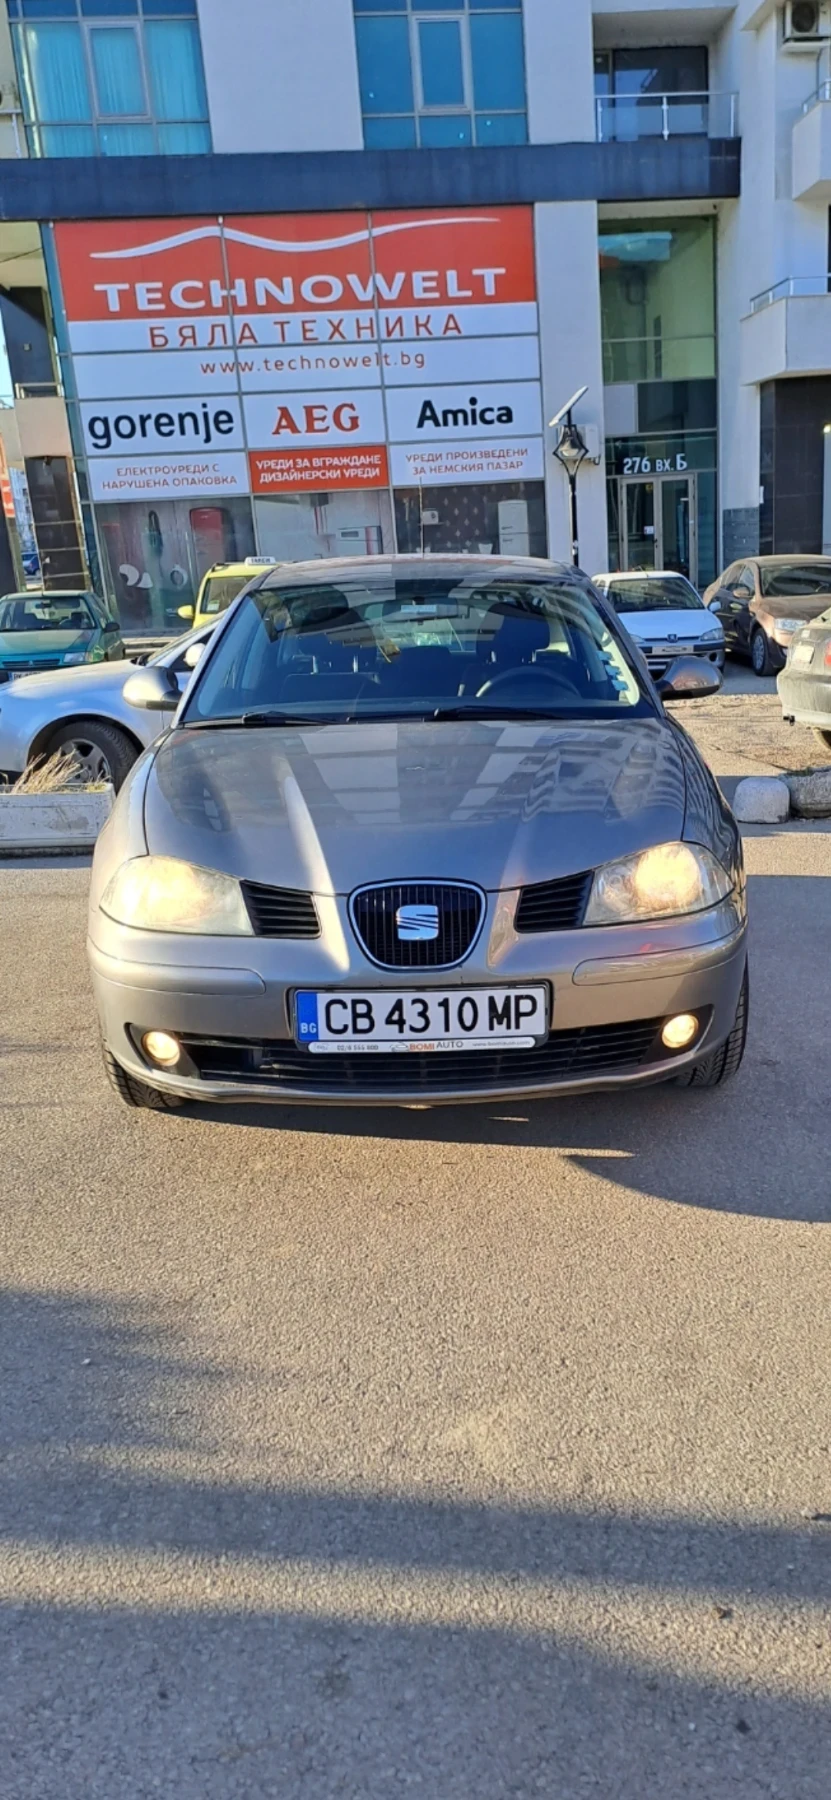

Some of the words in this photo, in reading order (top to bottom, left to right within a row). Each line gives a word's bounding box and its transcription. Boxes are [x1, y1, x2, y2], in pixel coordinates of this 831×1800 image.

[93, 267, 506, 312] TECHNOWELT
[149, 322, 258, 348] БЯЛА
[273, 313, 462, 344] ТЕХНИКА
[200, 352, 426, 374] www.technowelt.bg
[271, 403, 360, 435] AEG
[416, 397, 513, 429] Amica
[88, 402, 234, 450] gorenje
[256, 459, 293, 470] УРЕДИ
[296, 458, 310, 468] ЗА
[312, 455, 381, 468] ВГРАЖДАНЕ
[405, 453, 443, 463] УРЕДИ
[445, 448, 529, 461] ПРОИЗВЕДЕНИ
[623, 456, 651, 475] 276
[676, 453, 687, 471] Б
[116, 464, 209, 477] ЕЛЕКТРОУРЕДИ
[260, 469, 341, 483] ДИЗАЙНЕРСКИ
[343, 468, 380, 478] УРЕДИ
[413, 466, 426, 475] ЗА
[429, 463, 484, 474] НЕМСКИЯ
[487, 460, 524, 471] ПАЗАР
[102, 478, 170, 490] НАРУШЕНА
[172, 475, 237, 487] ОПАКОВКА
[385, 996, 479, 1034] 4310
[300, 1023, 317, 1034] BG
[409, 1043, 435, 1051] BOMI
[436, 1040, 464, 1049] AUTO
